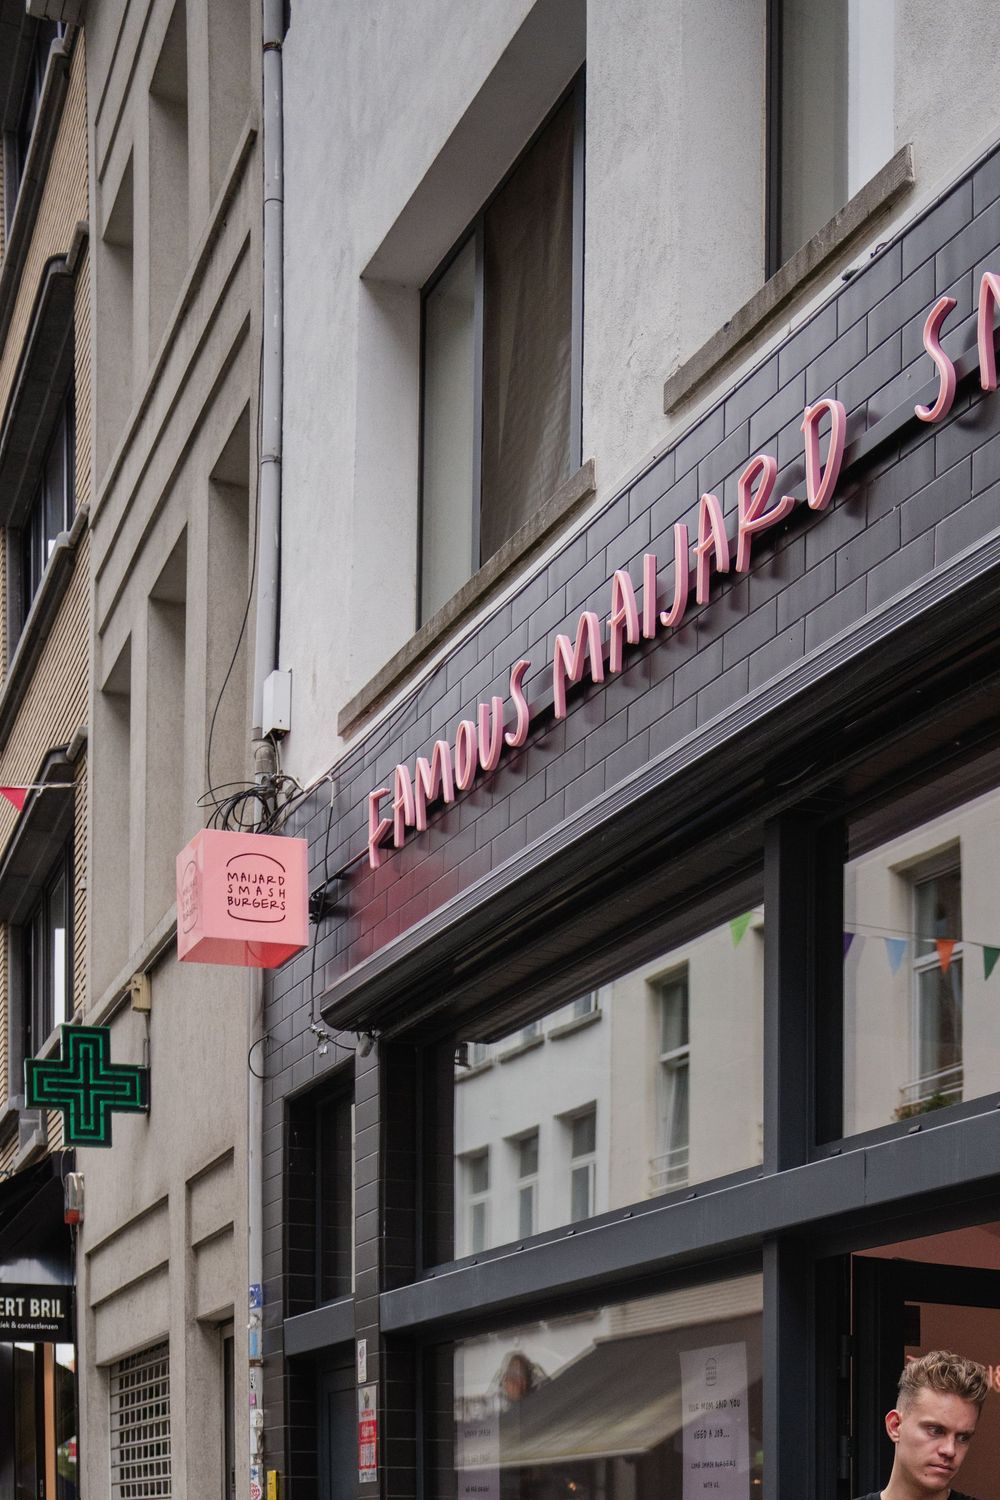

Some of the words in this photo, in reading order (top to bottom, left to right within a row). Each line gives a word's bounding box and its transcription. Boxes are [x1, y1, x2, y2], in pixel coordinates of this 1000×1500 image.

[368, 659, 532, 870] FAMOUS
[553, 398, 847, 719] MAIJARD
[227, 872, 285, 886] MAIJARD
[227, 884, 286, 899] SMASH
[227, 896, 286, 911] BURGERS
[30, 1298, 65, 1318] BRIL
[17, 1322, 59, 1330] contactlenzen
